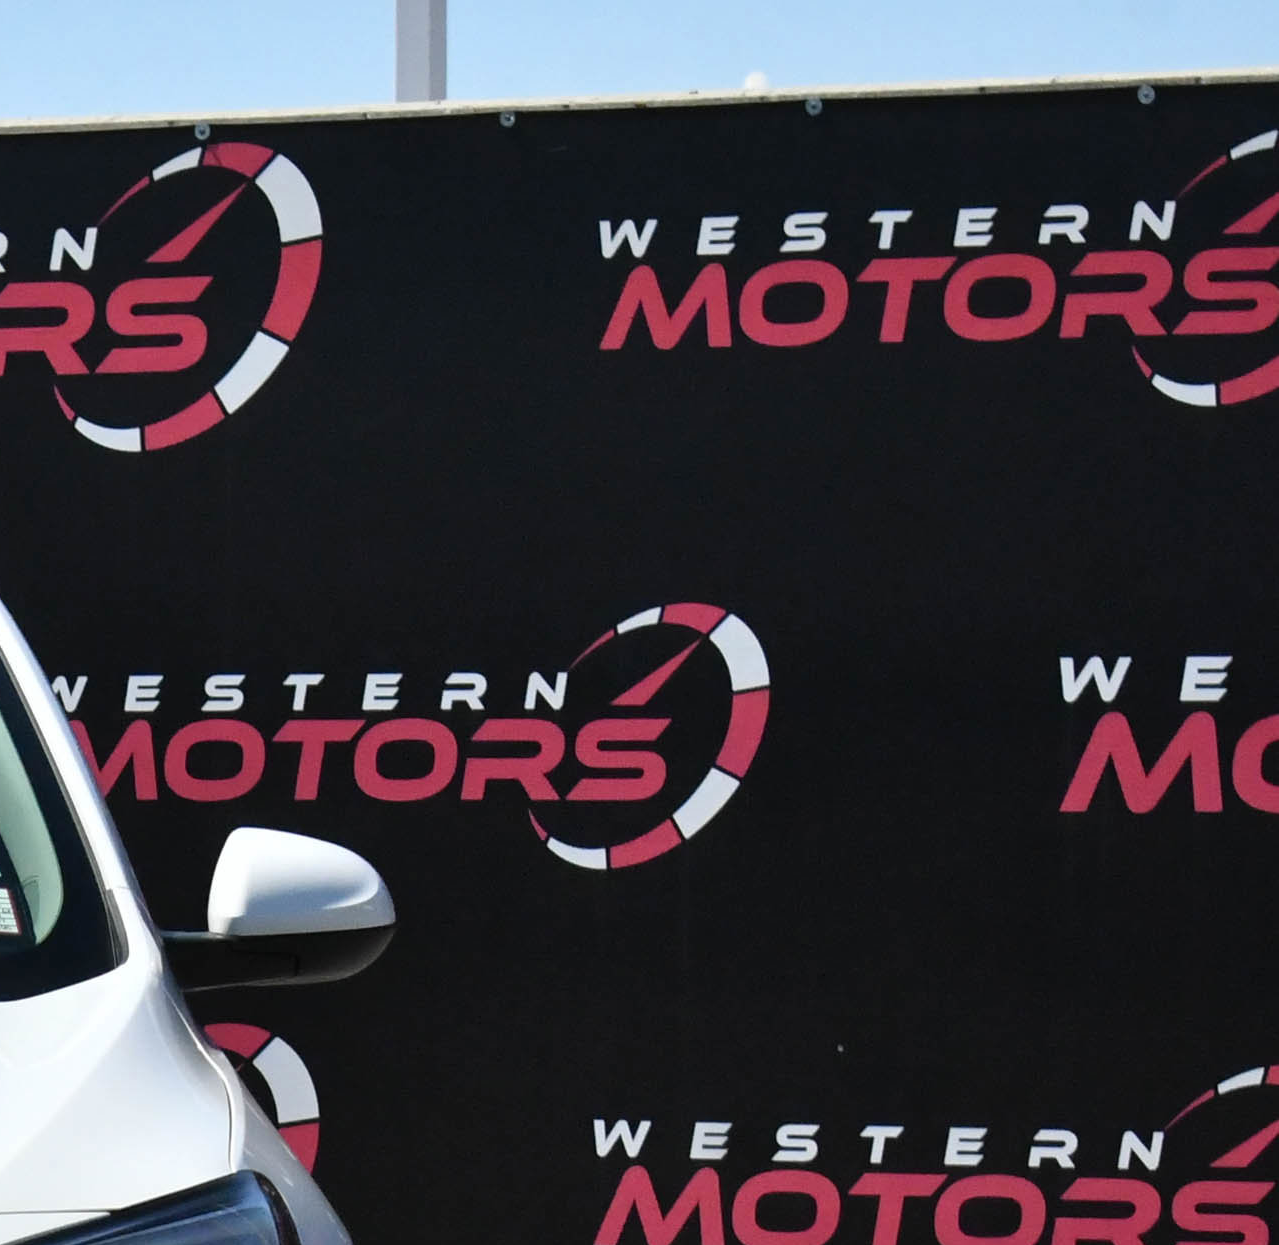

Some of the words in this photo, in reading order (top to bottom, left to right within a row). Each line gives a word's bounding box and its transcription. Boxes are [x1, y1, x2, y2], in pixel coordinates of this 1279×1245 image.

[599, 201, 1176, 258] WESTERN
[601, 246, 1279, 350] MOTORS
[51, 672, 568, 713] WESTERN
[70, 717, 672, 802] MOTORS
[594, 1119, 1164, 1170] WESTERN
